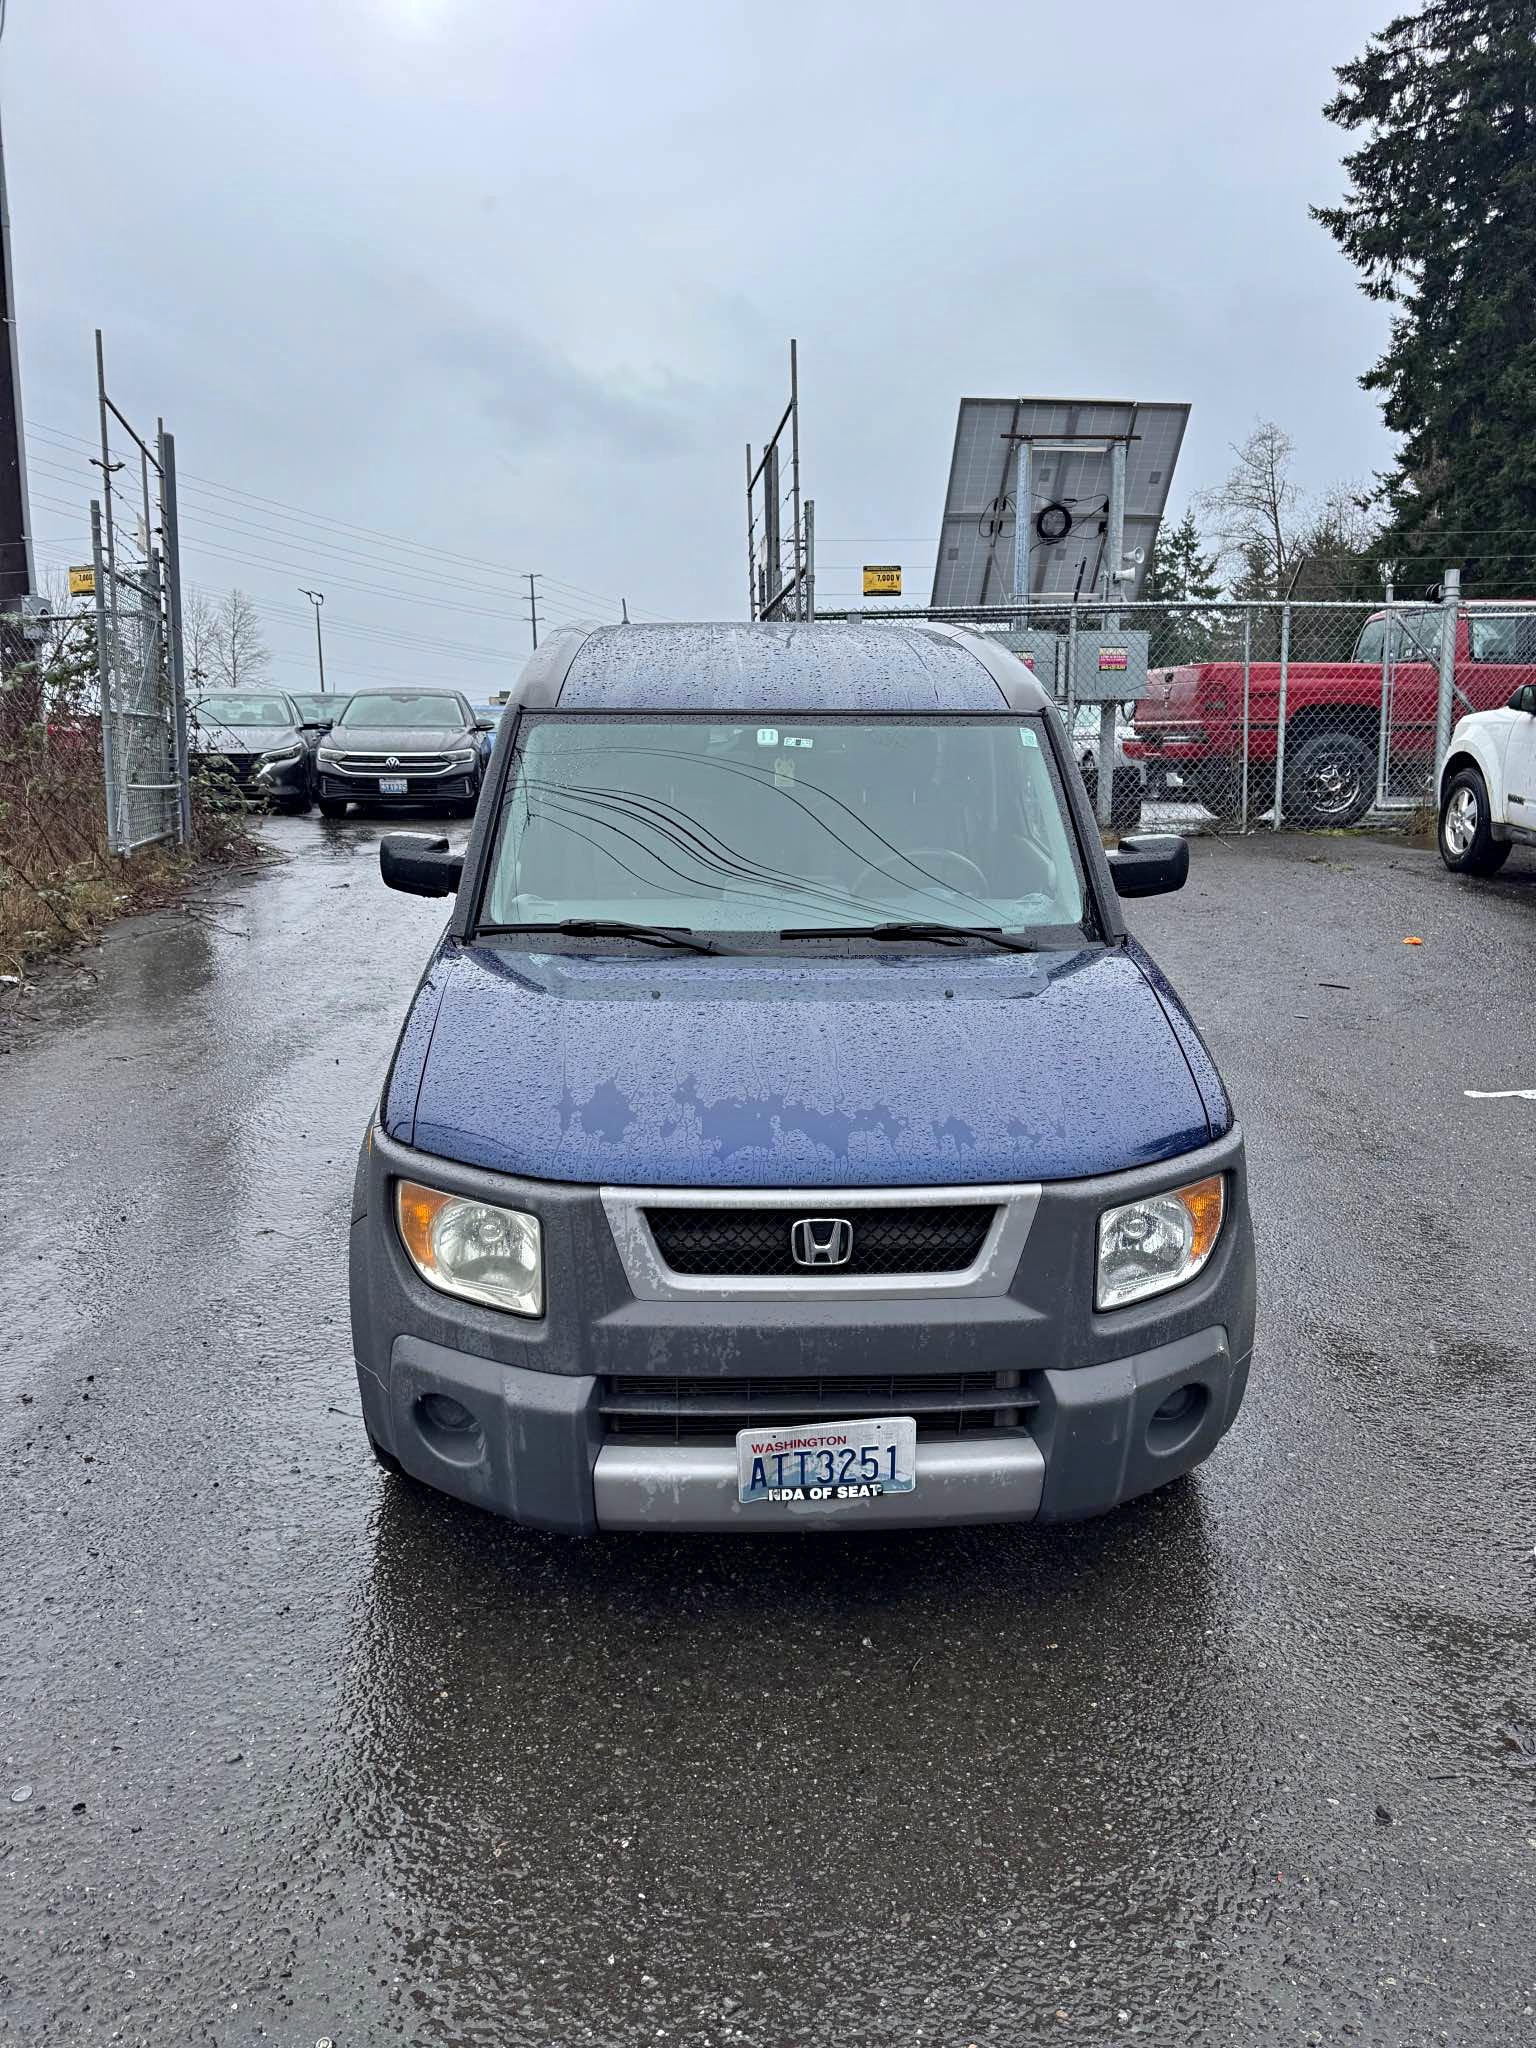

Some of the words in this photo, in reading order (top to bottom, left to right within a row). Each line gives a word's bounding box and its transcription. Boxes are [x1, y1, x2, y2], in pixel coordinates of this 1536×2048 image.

[751, 1434, 848, 1454] WASHINGTON
[750, 1445, 897, 1491] ATT3251
[809, 1487, 833, 1501] OF
